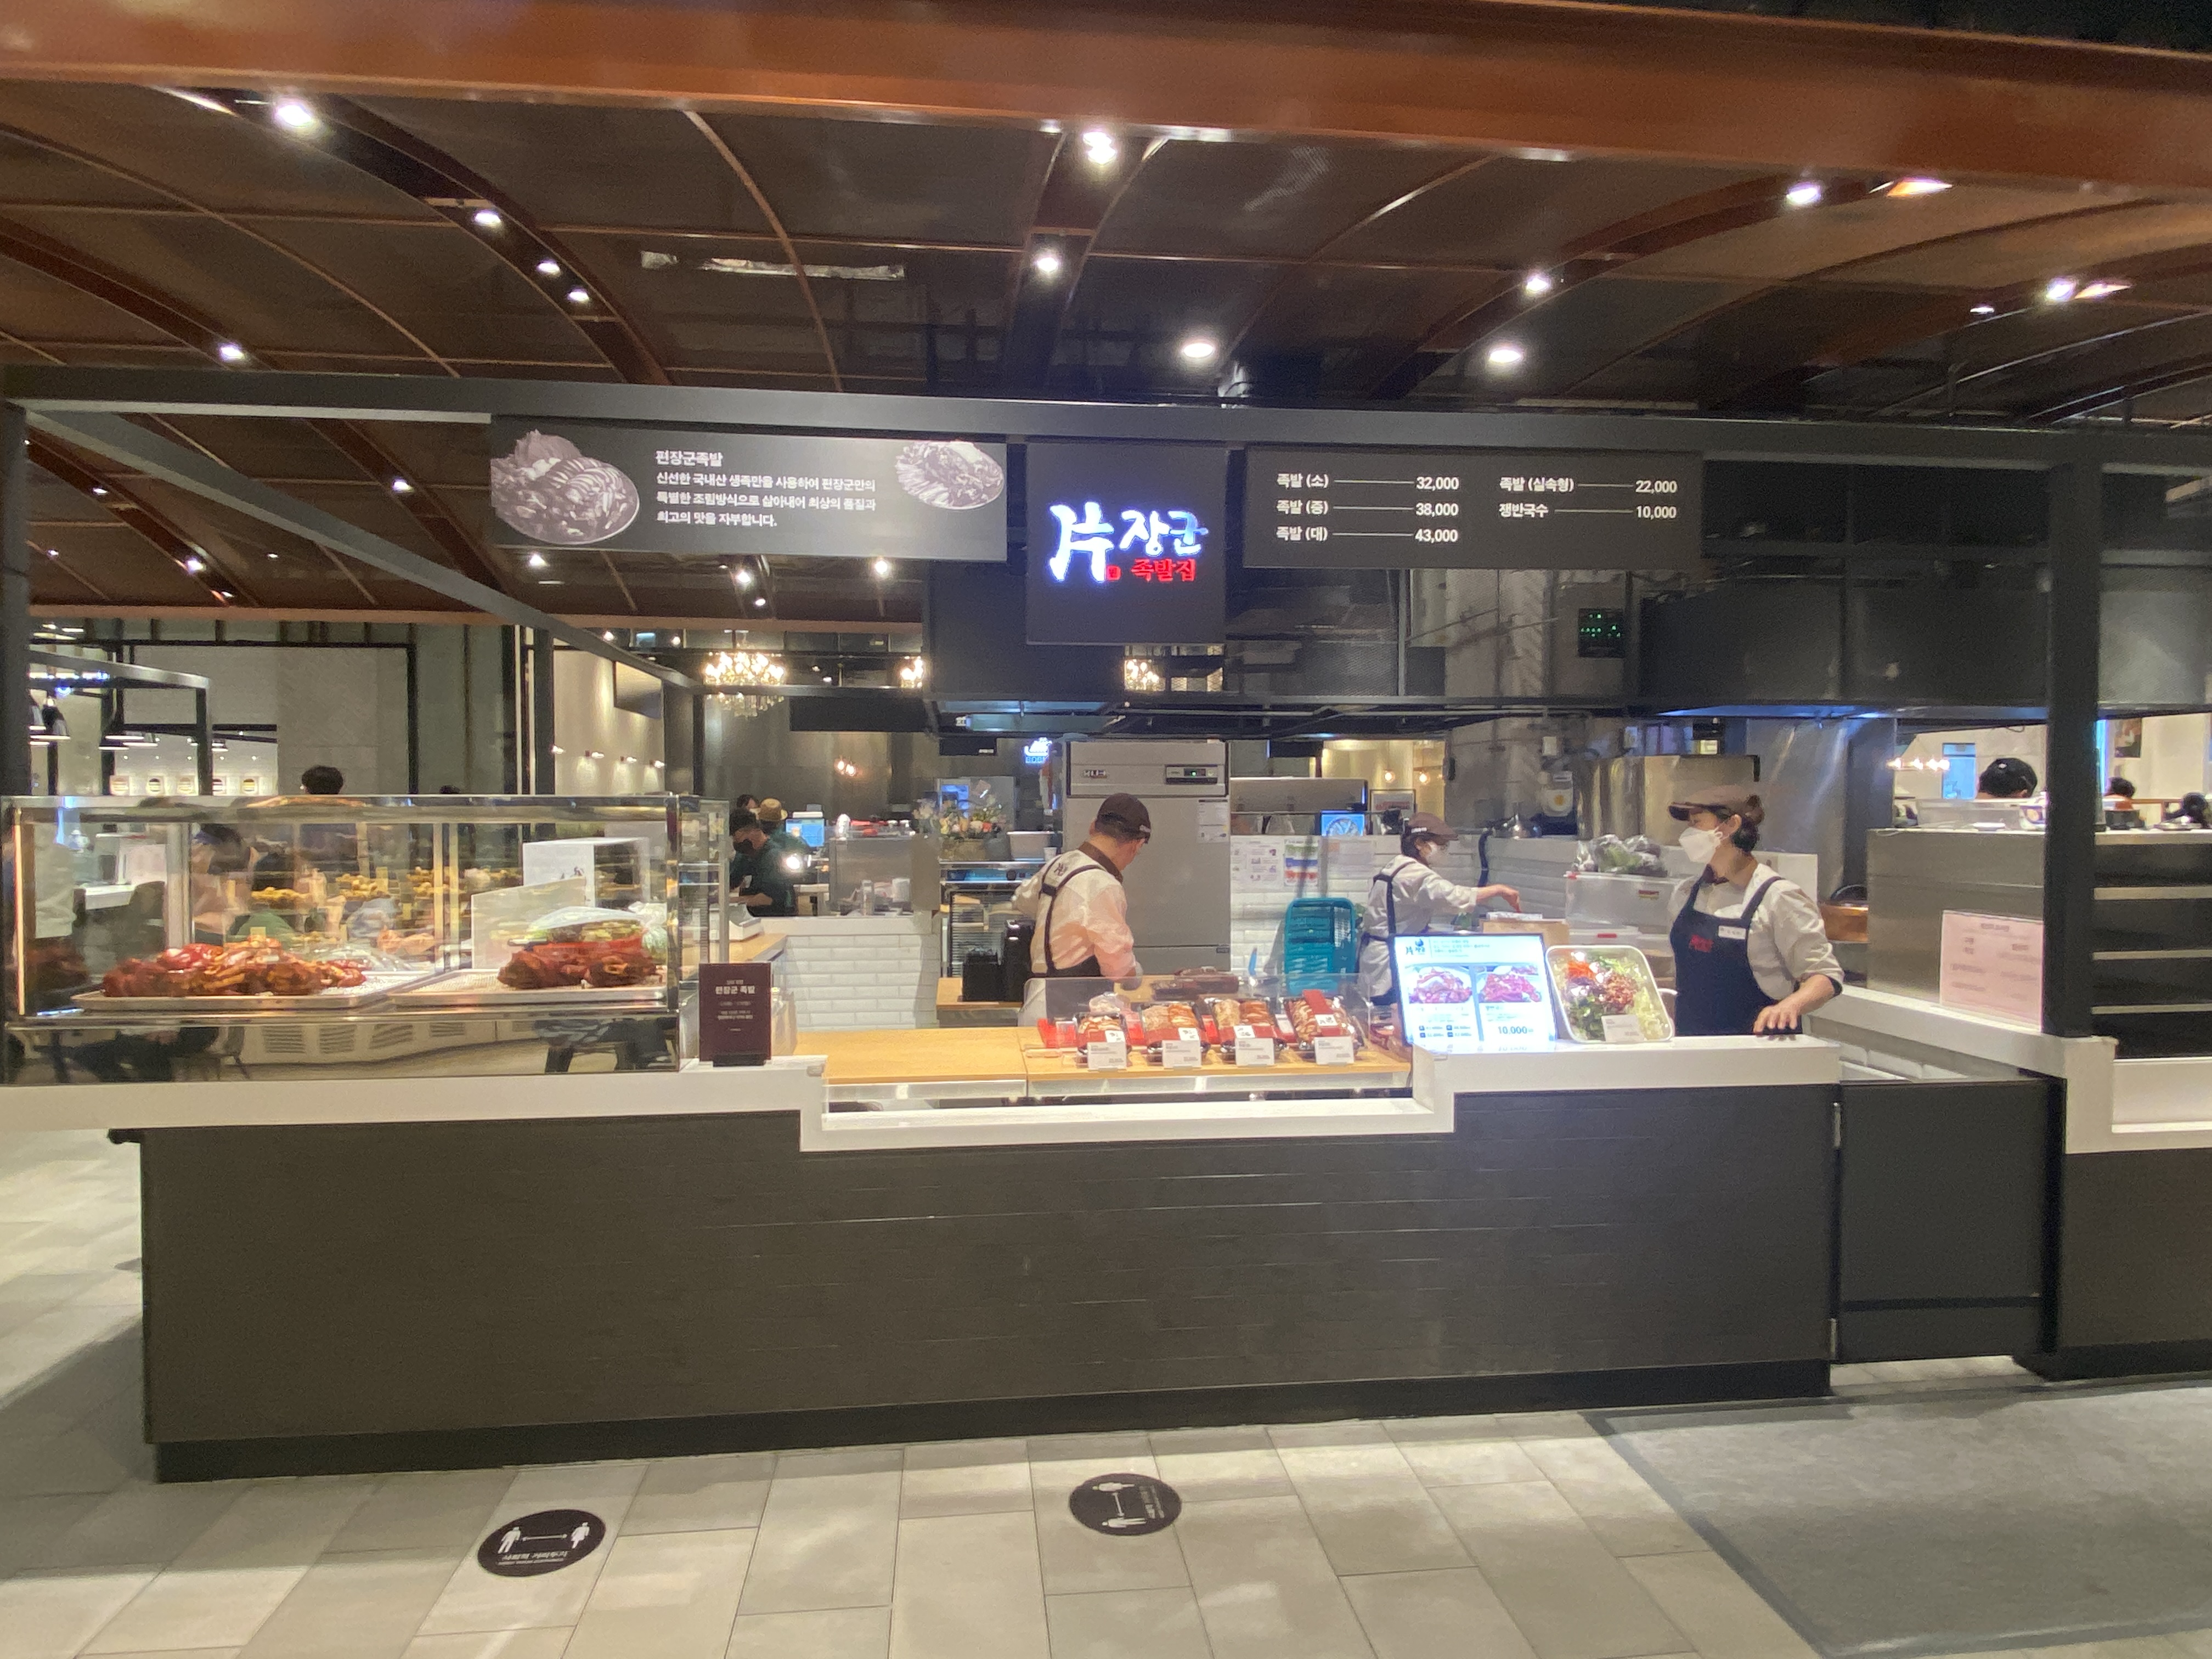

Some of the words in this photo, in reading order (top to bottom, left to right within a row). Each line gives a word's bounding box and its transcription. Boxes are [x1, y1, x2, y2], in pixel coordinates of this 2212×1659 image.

[656, 450, 723, 467] 편장군족발
[657, 472, 691, 485] 신선한
[693, 473, 727, 486] 국내산
[729, 474, 774, 489] 생족만을
[775, 476, 819, 490] 사용하여
[822, 478, 876, 492] 편장군만의
[1277, 473, 1303, 489] 족발
[1306, 473, 1329, 488] (소)
[1415, 476, 1460, 491] 32,000
[1499, 476, 1525, 492] 족발
[1528, 477, 1575, 492] (실속형)
[1635, 479, 1677, 494] 22,000
[657, 491, 691, 505] 특별한
[693, 493, 760, 506] 조림방식으로
[808, 496, 841, 510] 최상의
[843, 497, 876, 511] 품질과
[1276, 499, 1302, 515] 족발
[1306, 500, 1329, 516] (중)
[1415, 502, 1459, 517] 38,000
[657, 511, 691, 524] 최고의
[693, 511, 716, 525] 맛을
[719, 513, 777, 527] 자부합니다.
[1499, 503, 1549, 518] 쟁반국수
[1636, 505, 1677, 521] 10,000
[1276, 526, 1302, 541] 족발
[1305, 527, 1328, 541] (대)
[1414, 528, 1459, 544] 43,000
[1131, 558, 1197, 582] 족발집
